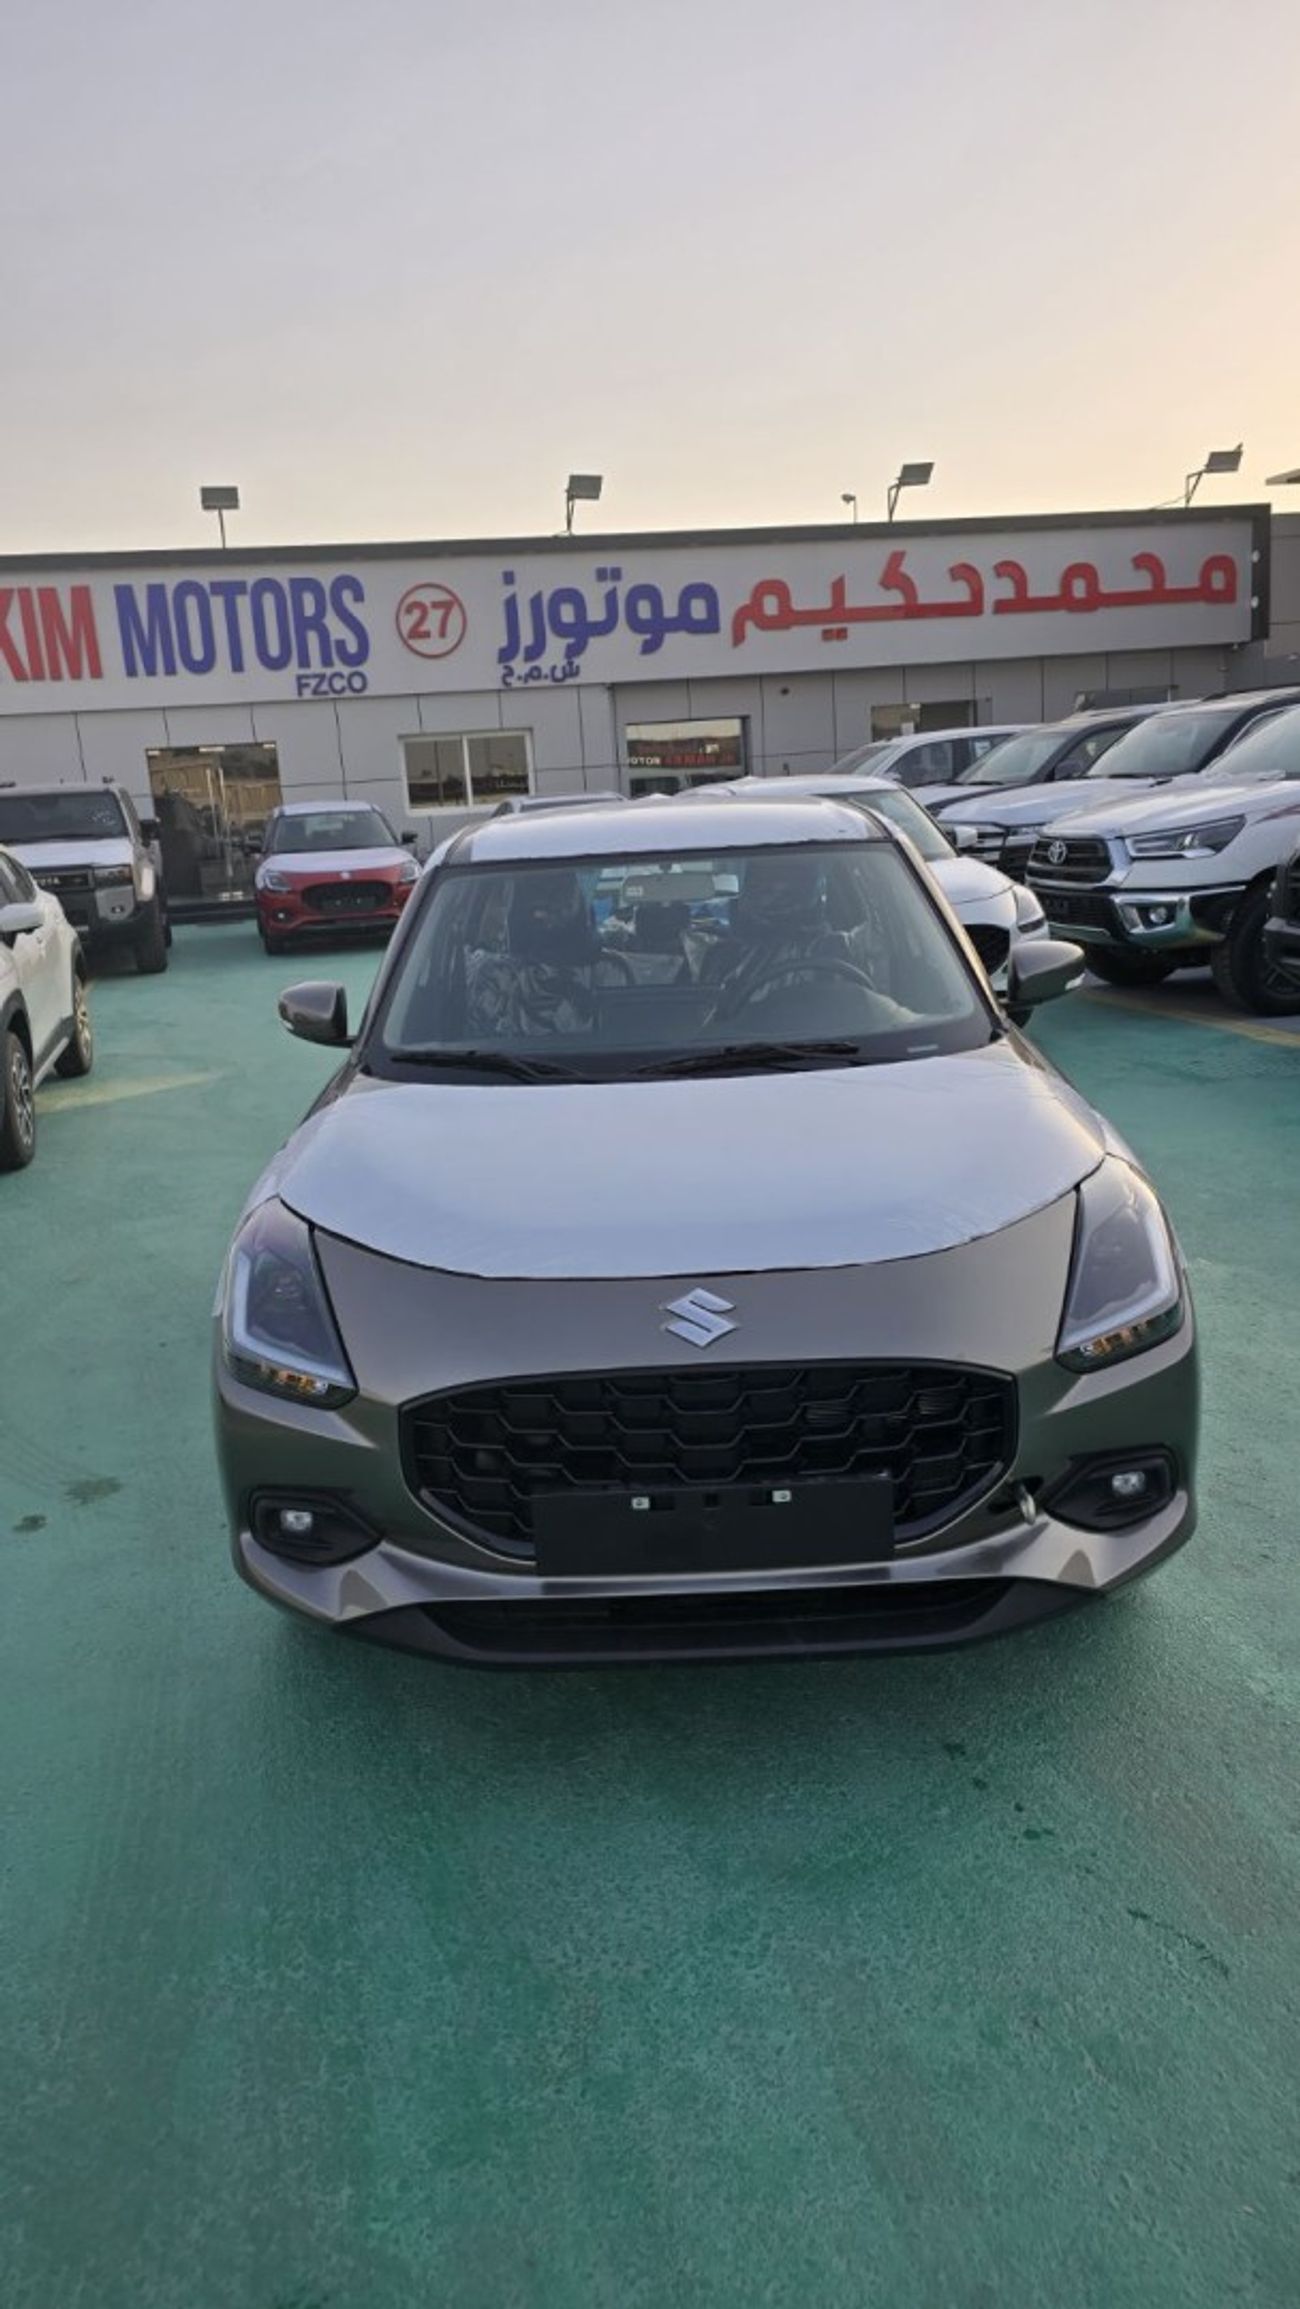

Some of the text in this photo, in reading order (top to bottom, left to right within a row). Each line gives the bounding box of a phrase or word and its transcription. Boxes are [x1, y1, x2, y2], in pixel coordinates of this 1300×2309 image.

[113, 574, 371, 678] MOTORS
[404, 600, 456, 641] 27
[497, 550, 1238, 664] محمد حكيم موتورز
[295, 671, 368, 697] FZCO
